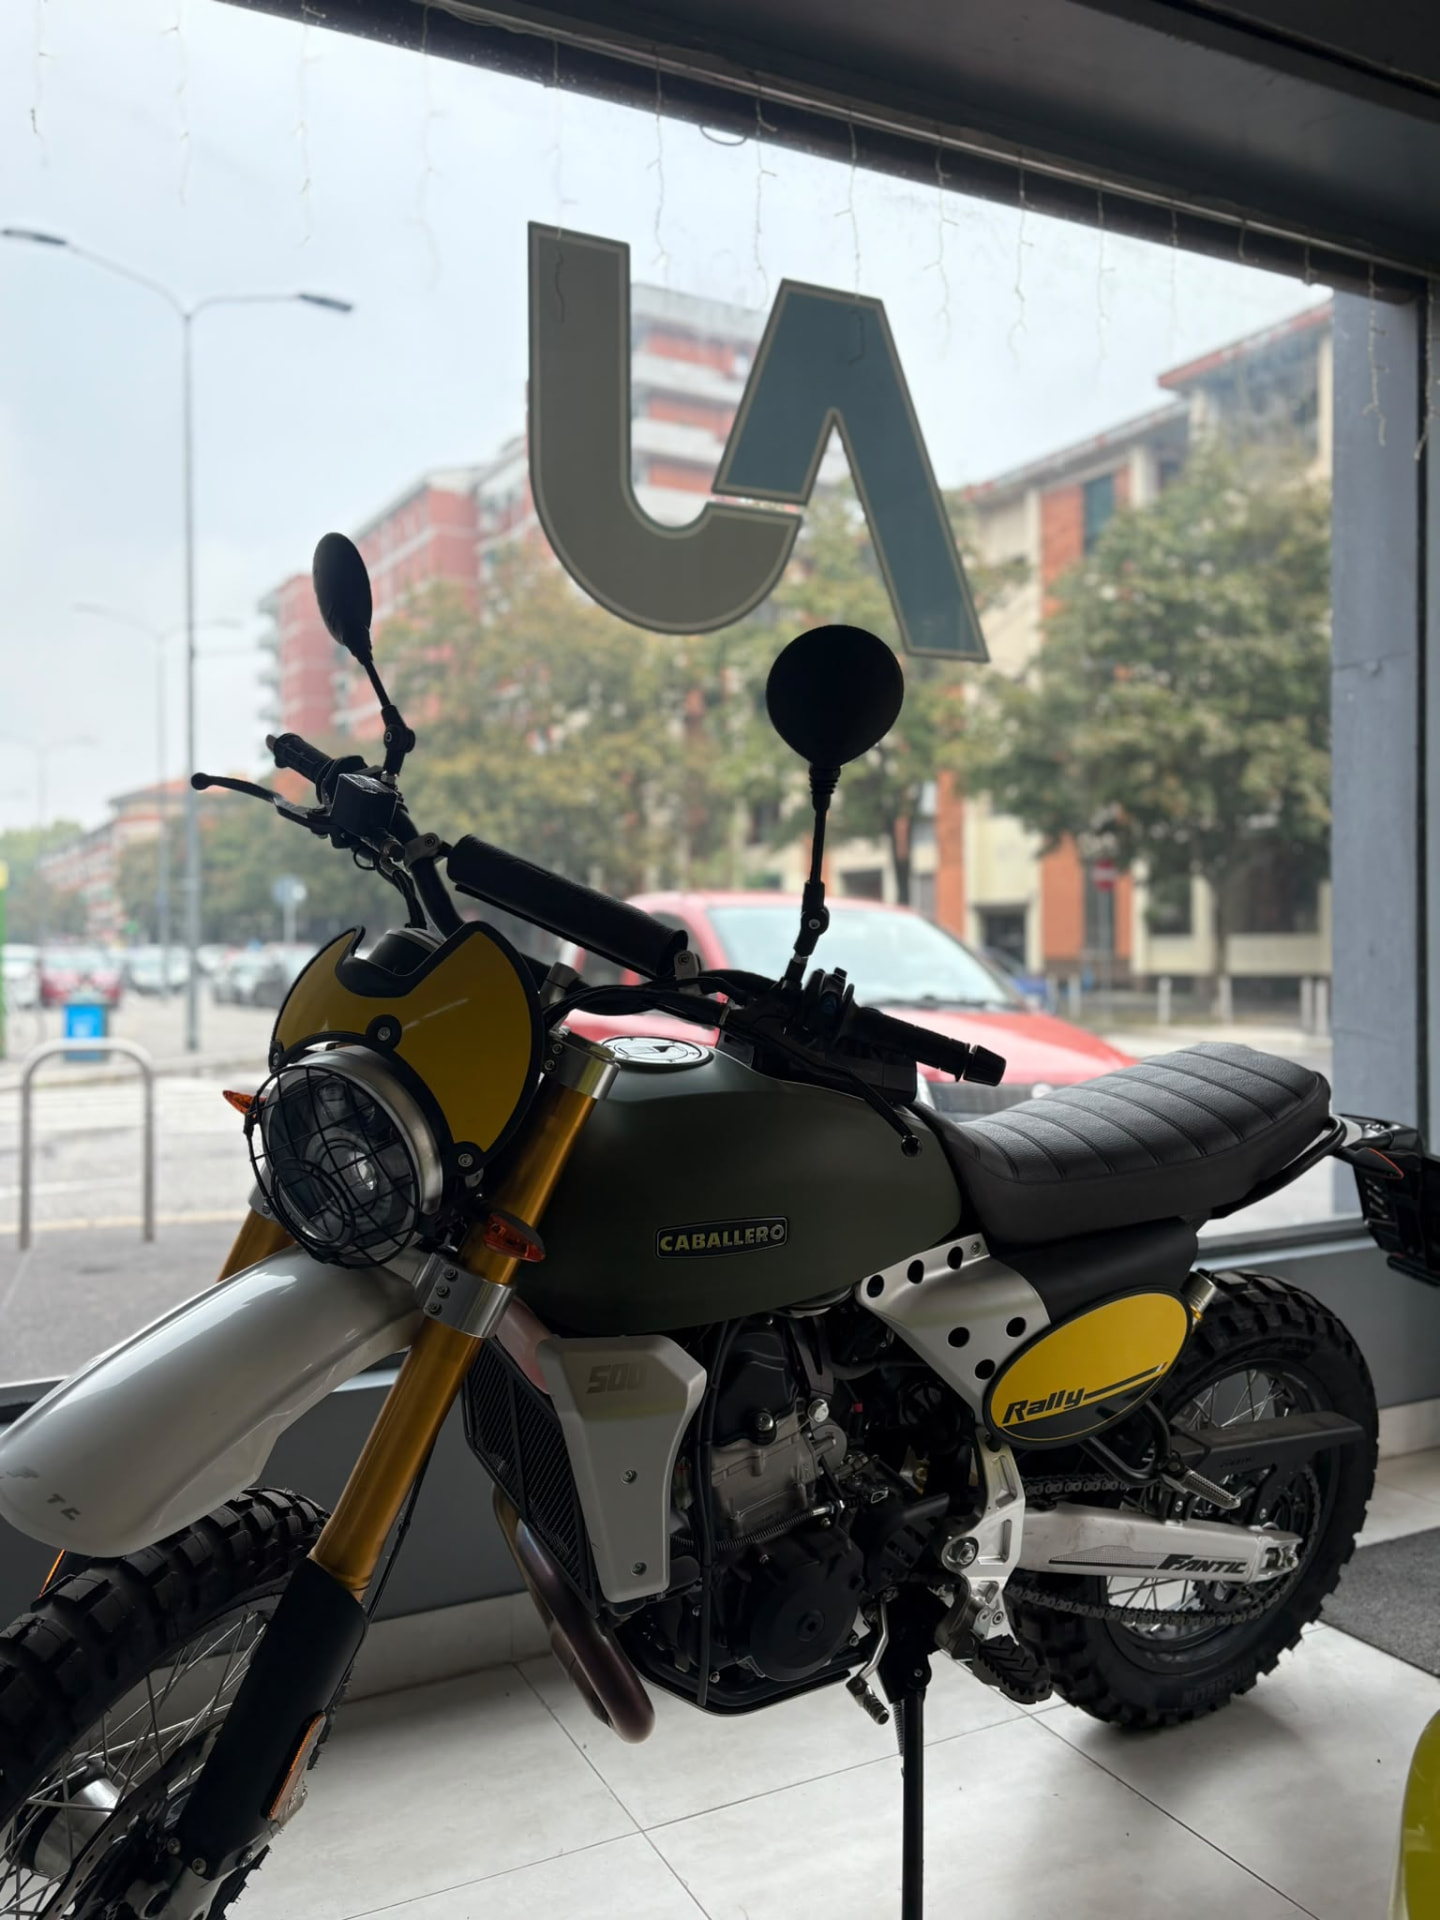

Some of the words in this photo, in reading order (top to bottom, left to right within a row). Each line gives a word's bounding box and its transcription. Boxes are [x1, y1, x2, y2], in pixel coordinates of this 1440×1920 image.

[659, 1224, 785, 1252] CABALLERO
[586, 1361, 647, 1394] 500
[1002, 1387, 1085, 1425] Rally
[1157, 1553, 1248, 1575] FANTIC
